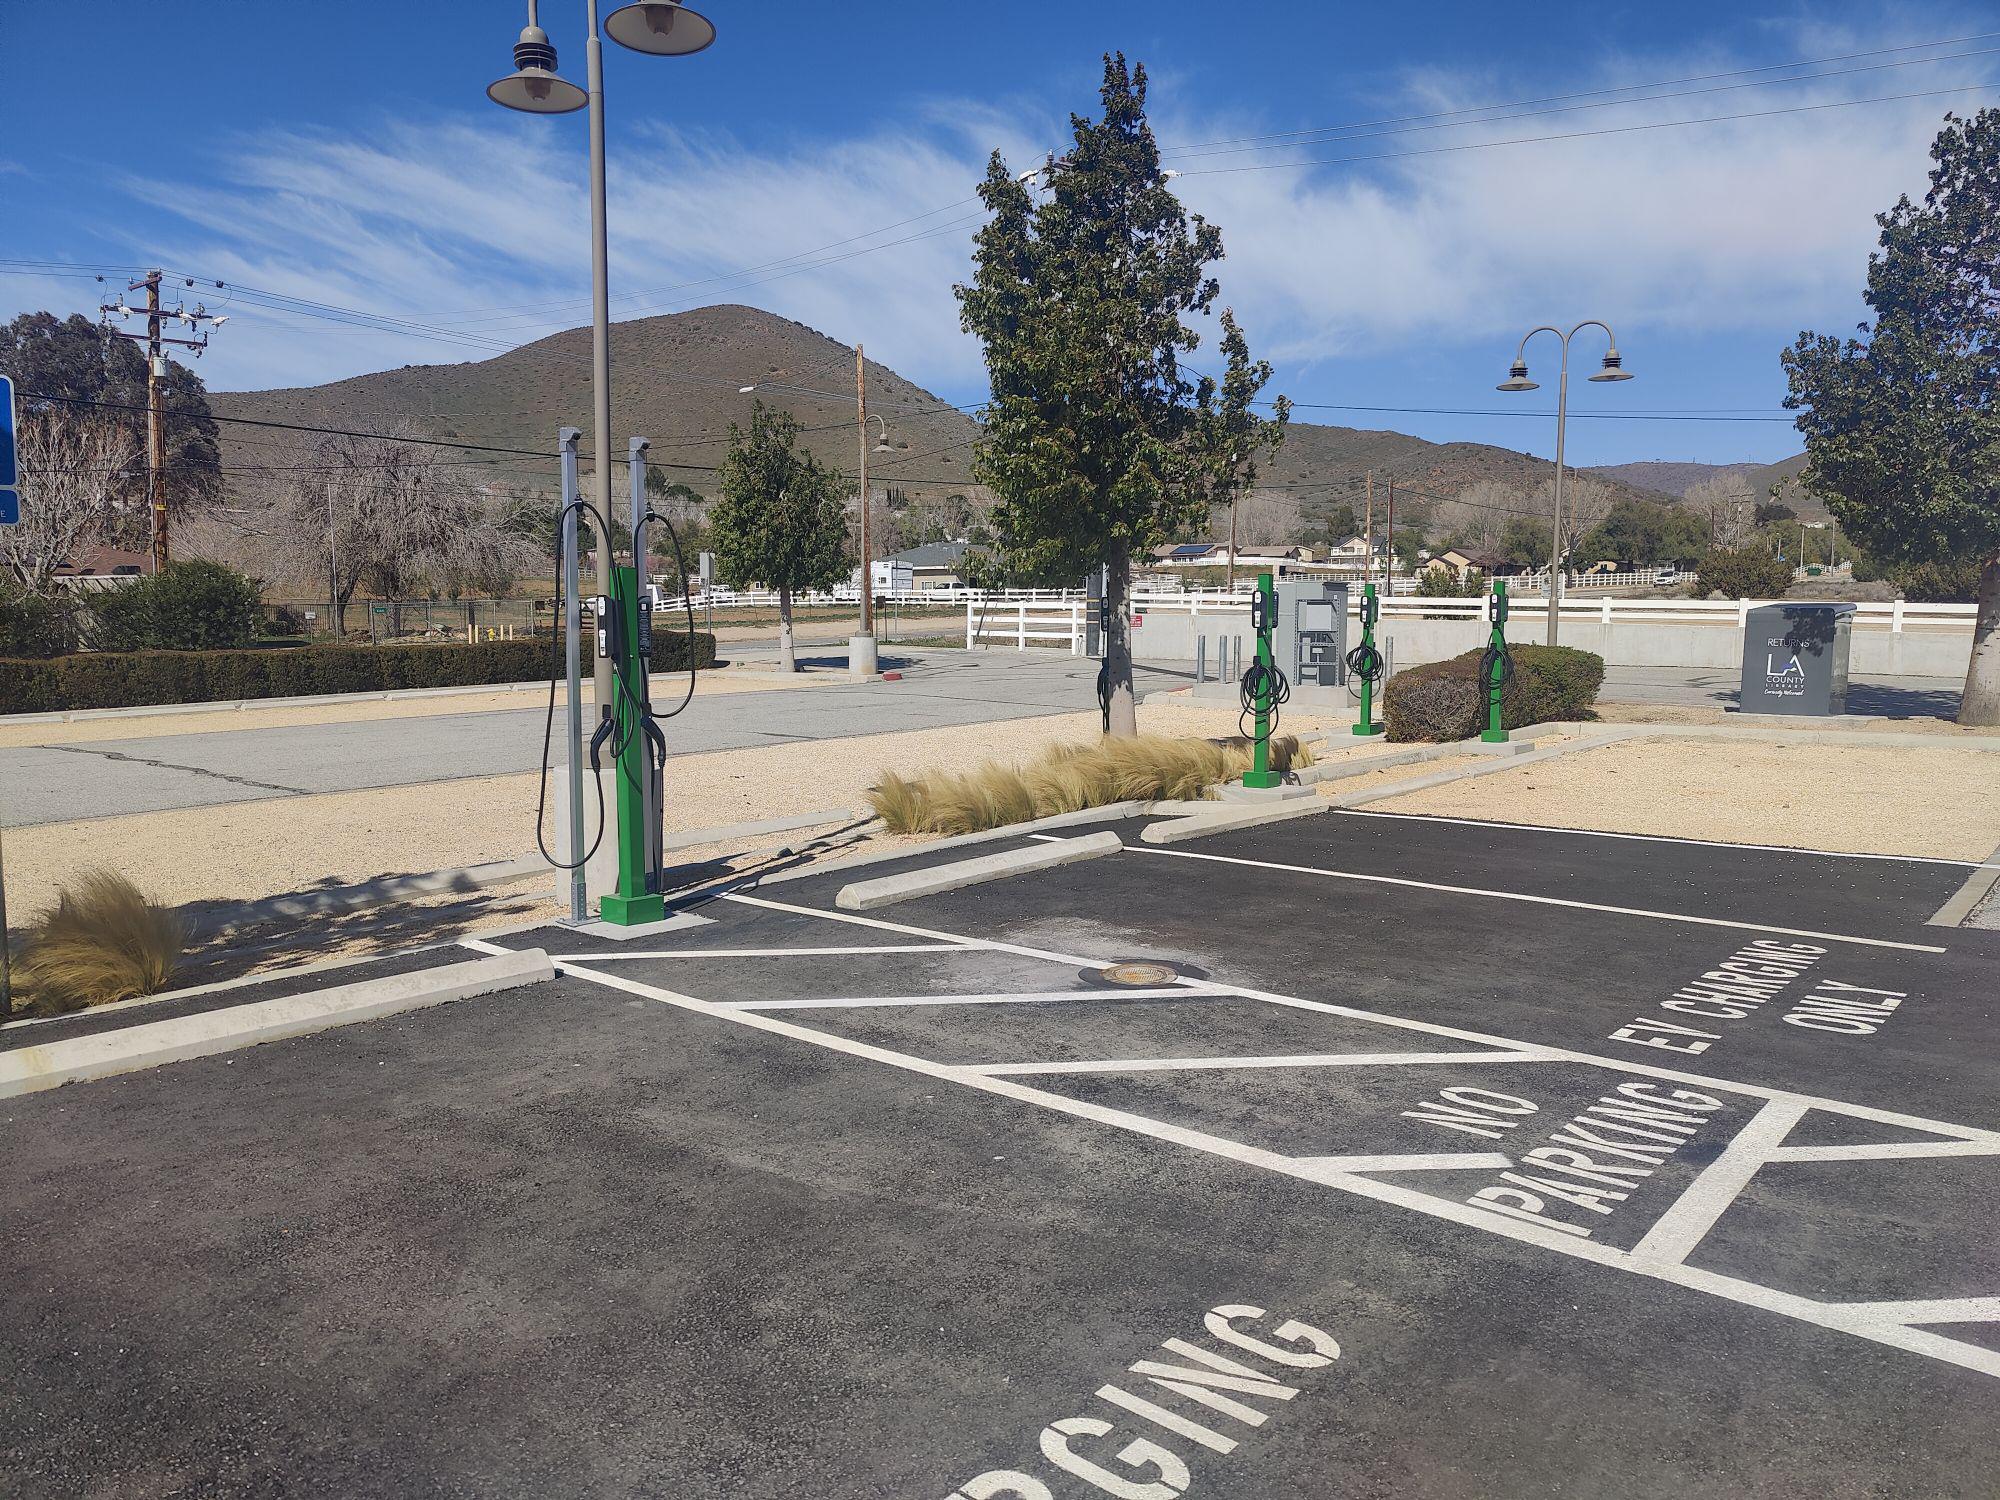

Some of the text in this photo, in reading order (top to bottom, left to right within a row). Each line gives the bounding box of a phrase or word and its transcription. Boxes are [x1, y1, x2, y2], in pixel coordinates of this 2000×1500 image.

[1766, 653, 1805, 677] LA
[1767, 638, 1810, 648] RETURNS
[1766, 676, 1805, 684] COUNTY
[1608, 940, 1828, 1055] EV CHARGING
[1783, 979, 1907, 1035] ONLY
[1401, 1086, 1539, 1139] NO
[1466, 1082, 1724, 1237] PARKING
[943, 1304, 1341, 1500] GING
